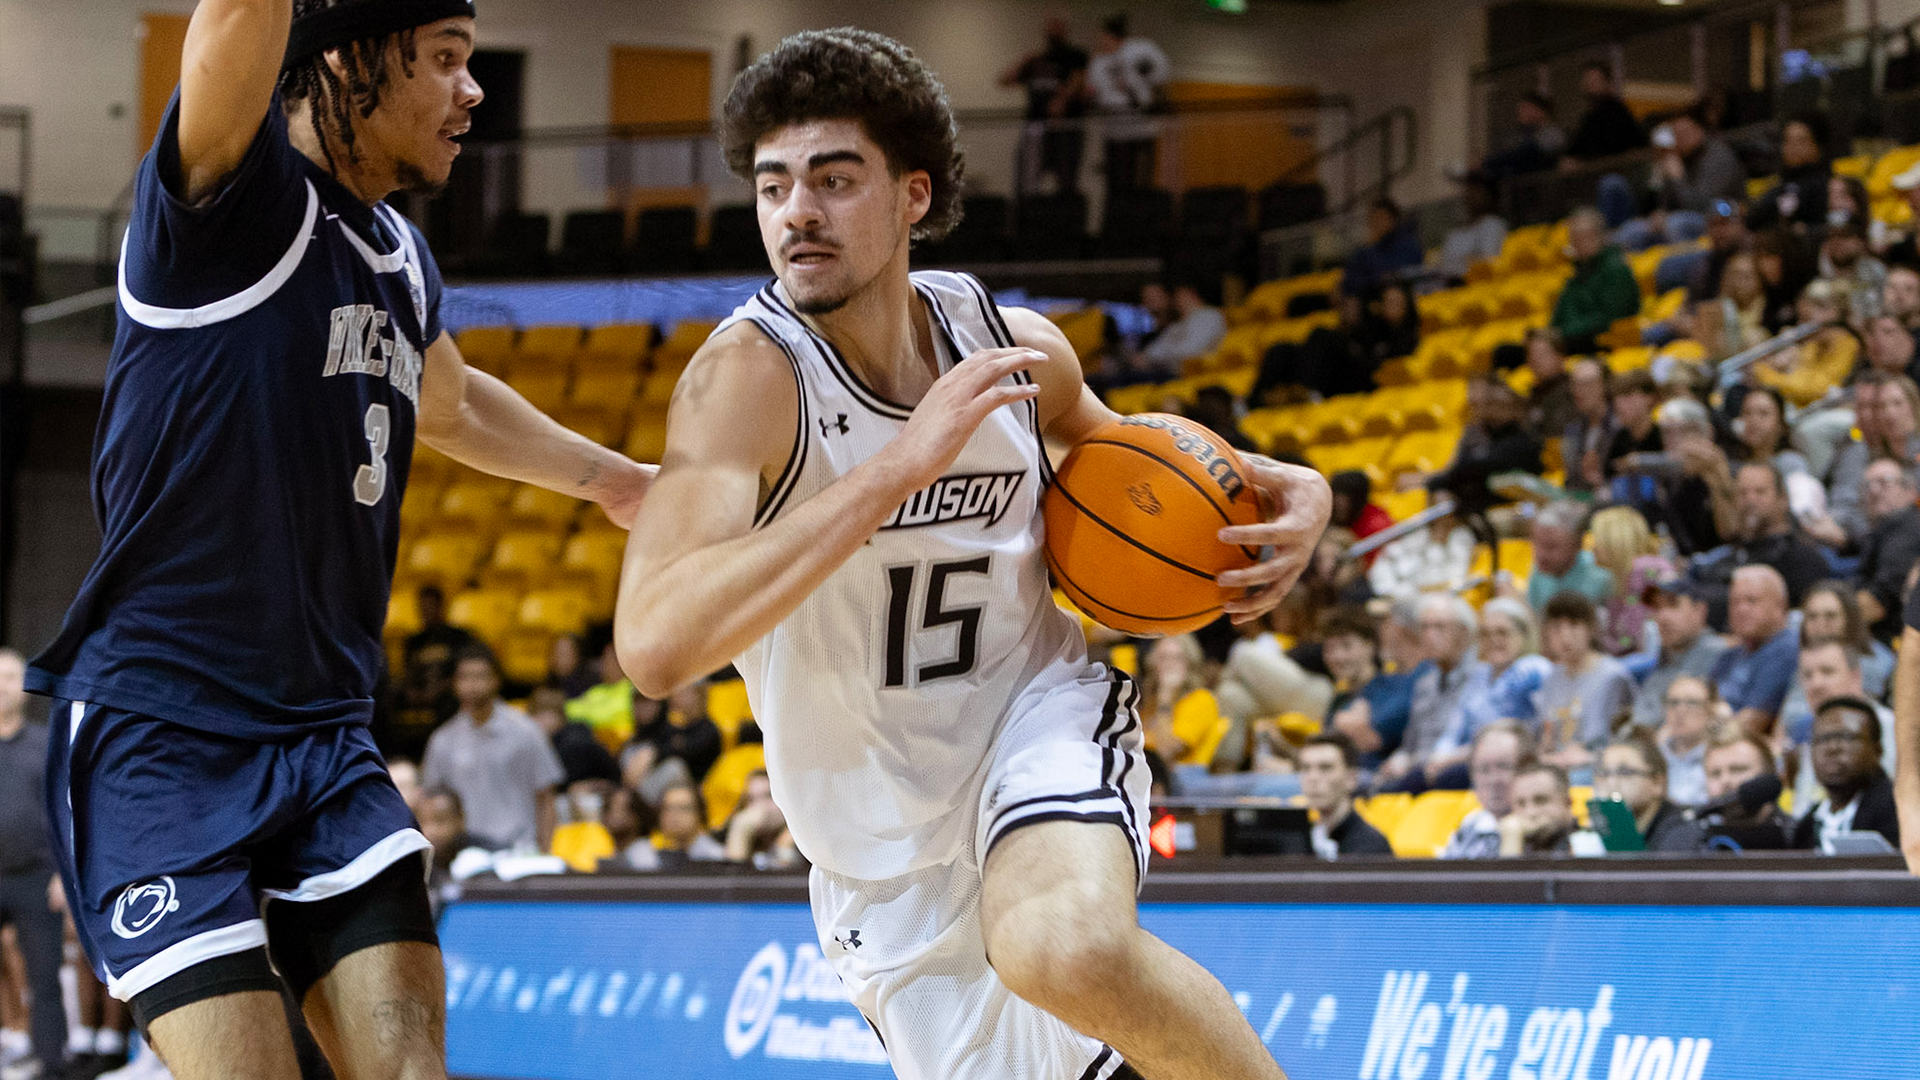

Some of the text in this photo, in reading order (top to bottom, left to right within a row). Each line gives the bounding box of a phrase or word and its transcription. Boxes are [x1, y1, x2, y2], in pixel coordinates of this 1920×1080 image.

[353, 403, 390, 506] 3
[879, 473, 1026, 529] WSON
[881, 554, 993, 689] 15
[1358, 969, 1509, 1080] We've
[1507, 984, 1615, 1080] got
